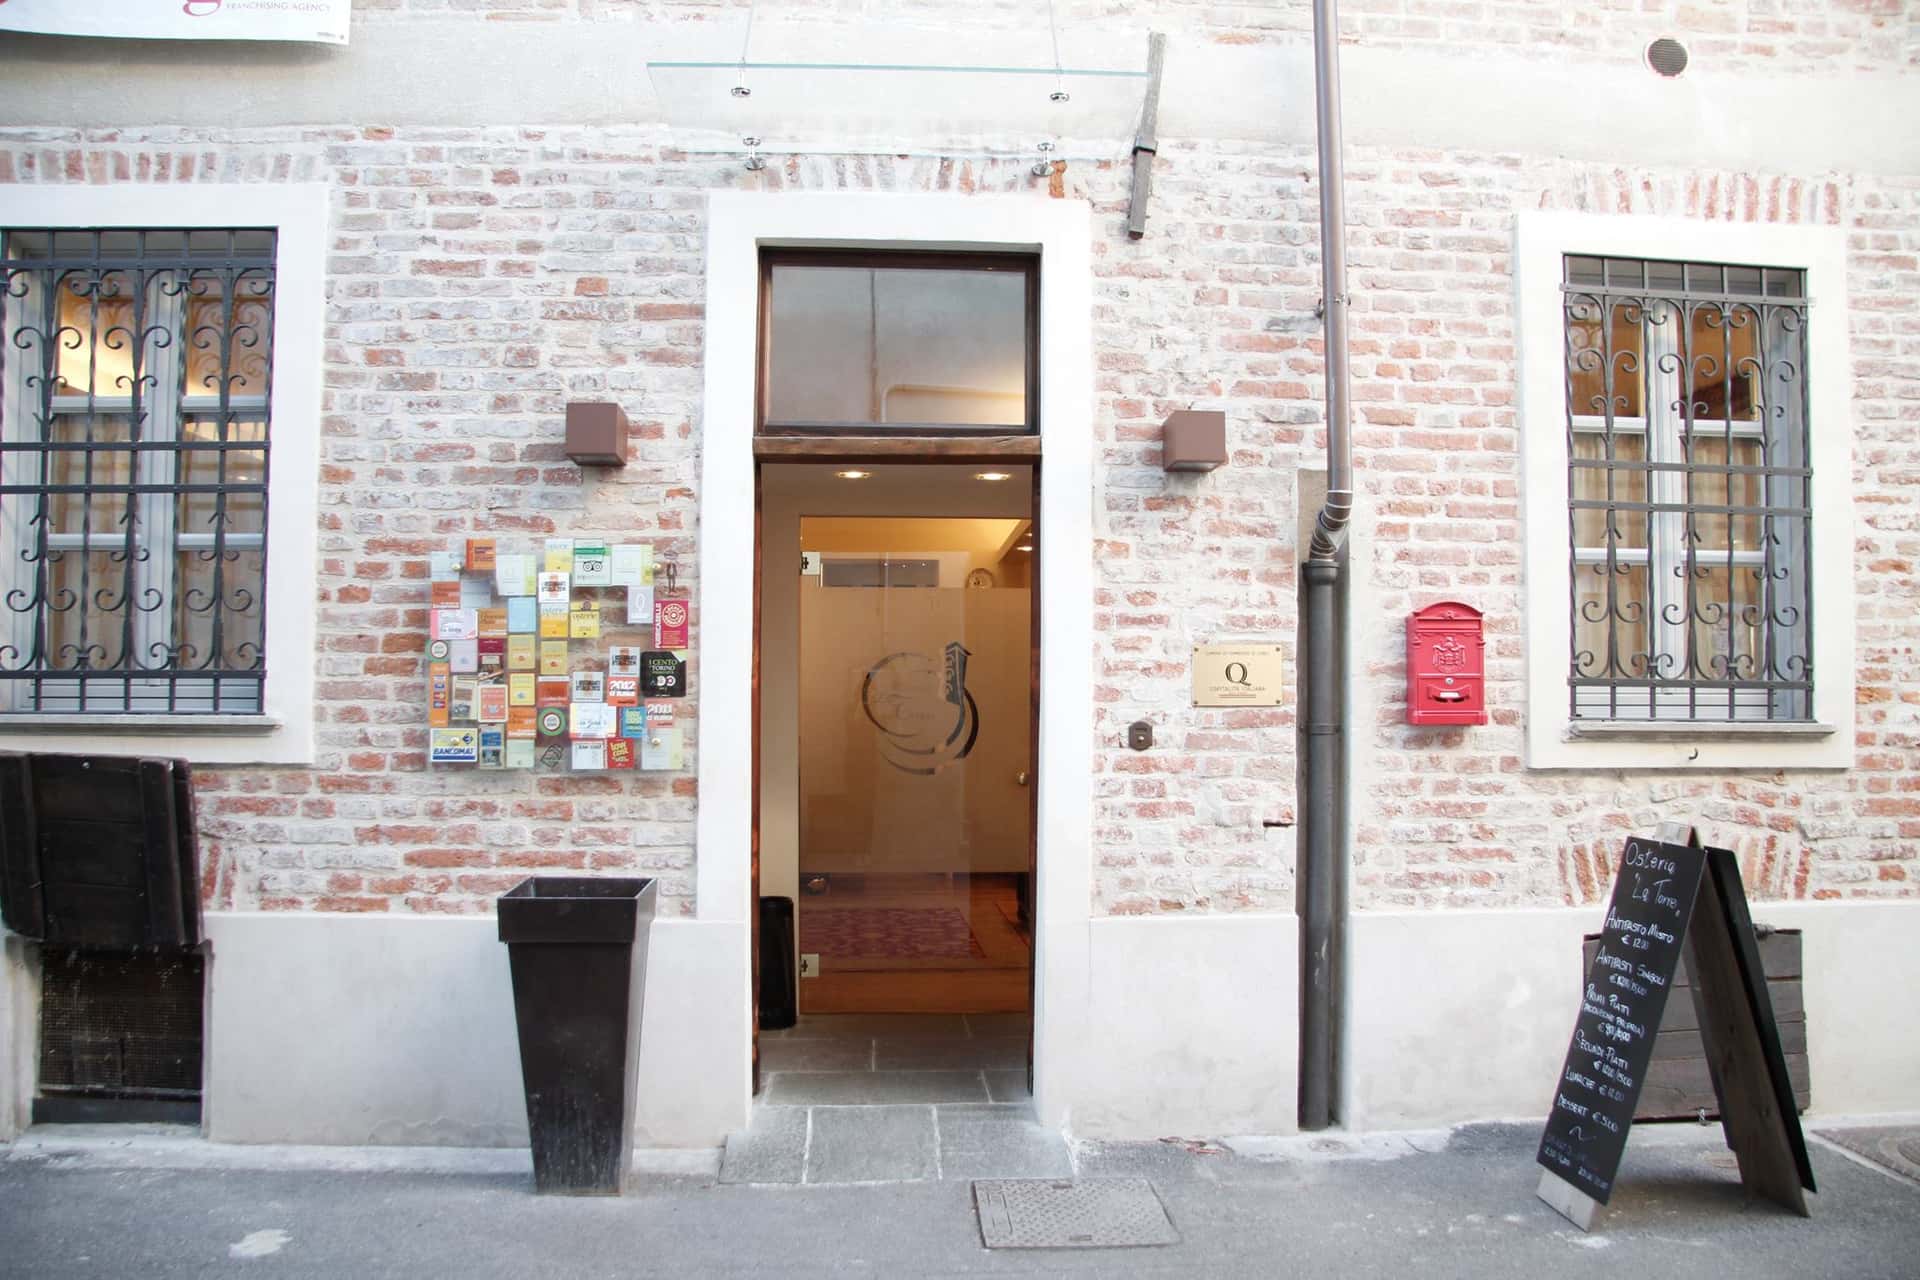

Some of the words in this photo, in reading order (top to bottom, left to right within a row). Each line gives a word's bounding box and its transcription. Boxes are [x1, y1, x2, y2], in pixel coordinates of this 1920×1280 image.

[291, 2, 331, 13] AGENCY
[1225, 662, 1252, 686] Q
[609, 680, 636, 689] 2012
[433, 747, 474, 755] BANCOMAT
[1625, 842, 1676, 875] Osteria
